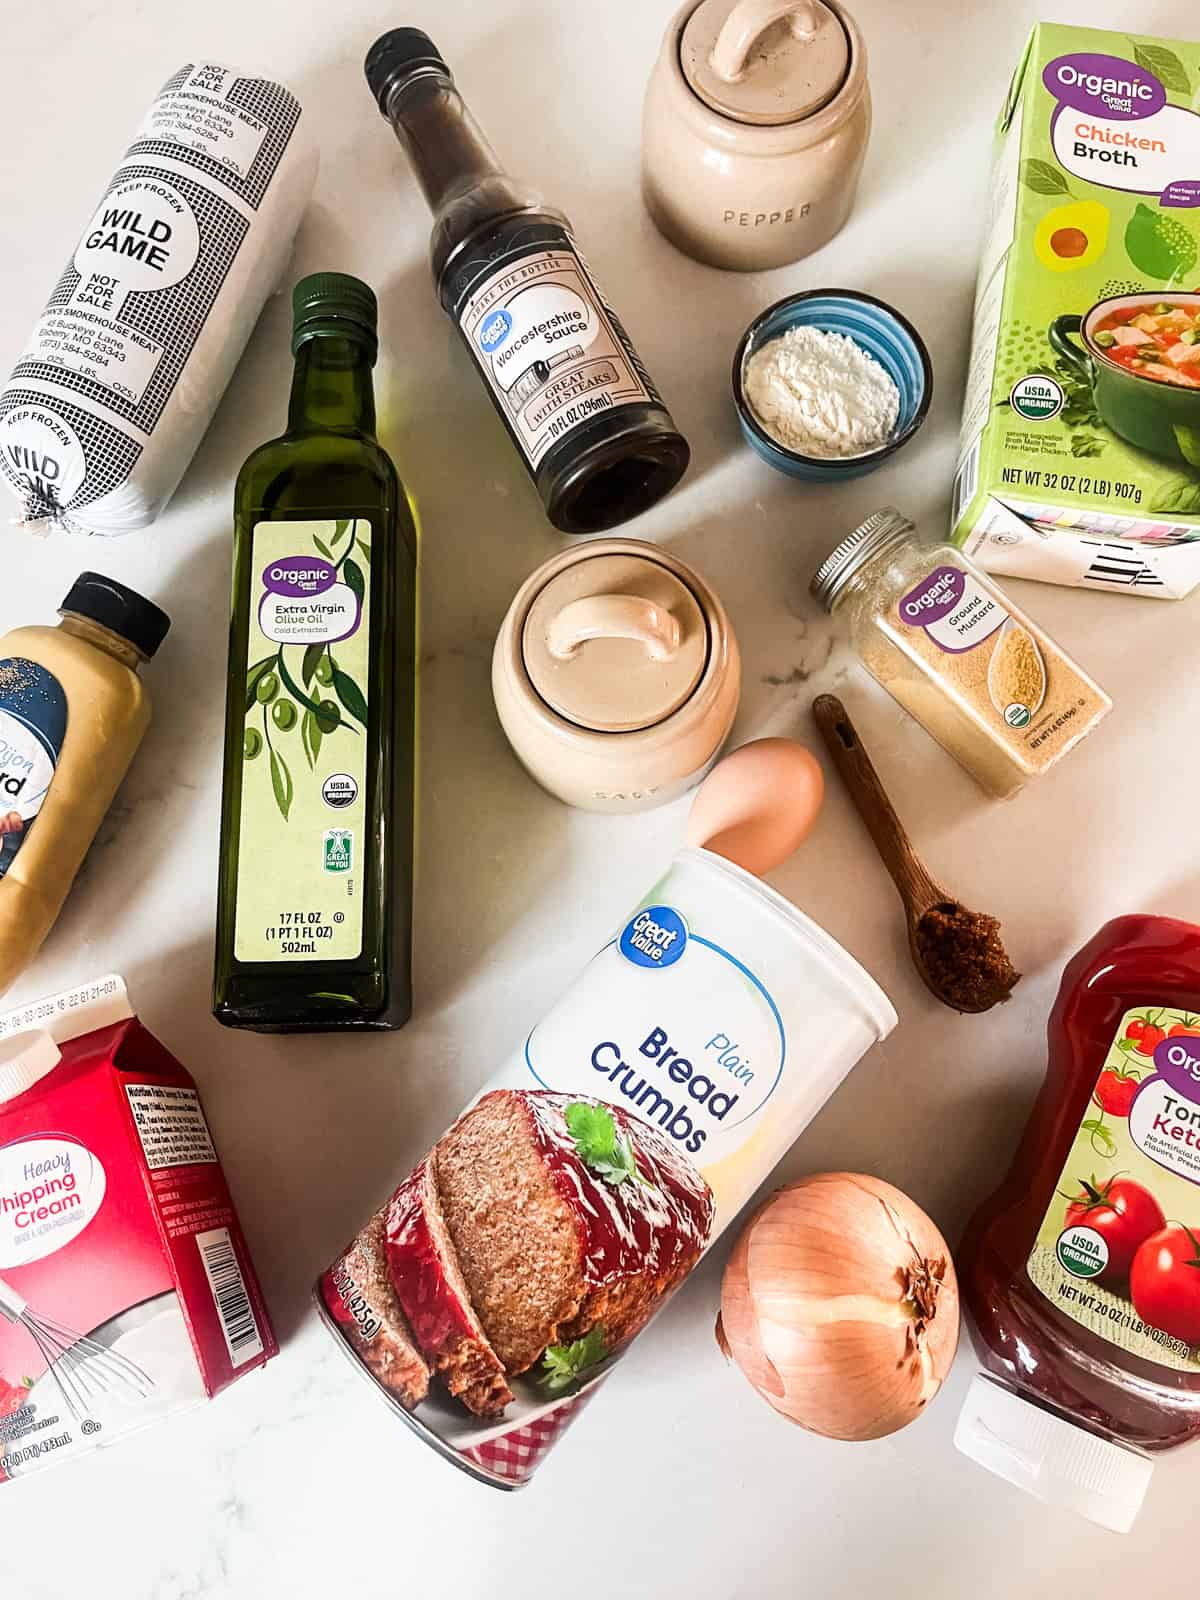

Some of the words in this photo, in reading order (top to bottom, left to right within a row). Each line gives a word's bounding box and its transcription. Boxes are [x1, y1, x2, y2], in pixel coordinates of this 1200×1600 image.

[197, 71, 224, 83] FOR
[202, 64, 230, 75] NOT
[1057, 65, 1153, 100] Organic
[190, 78, 223, 93] SALE
[1101, 94, 1132, 108] Great
[208, 109, 232, 127] Lane
[238, 111, 263, 131] MEAT
[1074, 123, 1167, 153] Chicken
[1072, 141, 1139, 168] Broth
[143, 183, 184, 213] FROZEN
[101, 209, 172, 243] WILD
[723, 202, 810, 227] PEPPER
[84, 230, 170, 272] GAME
[89, 273, 120, 289] NOT
[498, 273, 519, 292] THE
[520, 260, 562, 278] BOTTLE
[76, 292, 113, 312] SALE
[84, 283, 114, 299] FOR
[63, 308, 130, 338] SMOKEHOUSE
[130, 333, 159, 355] MEAT
[97, 331, 125, 351] Lane
[496, 310, 583, 368] Worcestershire
[543, 321, 588, 345] Sauce
[61, 342, 110, 368] 384-5284
[72, 332, 92, 345] MO
[93, 339, 127, 363] 63343
[533, 397, 562, 423] WITH
[562, 373, 612, 410] STEAKS
[544, 370, 585, 400] GREAT
[1023, 385, 1052, 398] USDA
[548, 423, 559, 438] 10
[559, 415, 569, 432] FL
[568, 408, 580, 423] OZ
[579, 391, 614, 419] (296mL)
[1019, 398, 1055, 409] ORGANIC
[7, 411, 30, 428] KEEP
[31, 411, 72, 447] FROZEN
[1002, 467, 1022, 485] NET
[1025, 471, 1042, 487] WT
[1043, 473, 1058, 489] 32
[1061, 475, 1075, 492] OZ
[1078, 477, 1090, 494] (2
[1093, 480, 1111, 498] LB)
[1114, 481, 1142, 503] 907g
[270, 567, 329, 585] Organic
[904, 573, 956, 617] Organic
[274, 615, 305, 625] Olive
[306, 614, 323, 624] Oil
[275, 604, 308, 615] Extra
[309, 603, 345, 615] Virgin
[948, 595, 983, 627] Ground
[957, 600, 996, 636] Mustard
[291, 625, 328, 634] Extracted
[330, 781, 351, 790] USDA
[326, 852, 349, 861] GREAT
[335, 860, 349, 869] YOU
[279, 912, 292, 924] 17
[294, 912, 306, 924] FL
[308, 911, 321, 924] OZ
[633, 911, 677, 949] Great
[265, 927, 275, 941] (1
[278, 927, 291, 939] PT
[294, 927, 300, 938] 1
[302, 926, 314, 938] FL
[316, 926, 333, 939] OZ)
[630, 930, 662, 960] Value
[281, 941, 317, 953] 502mL
[704, 1032, 755, 1088] Plain
[638, 1026, 740, 1121] Bread
[590, 1041, 707, 1153] Crumbs
[1145, 1133, 1158, 1143] No
[1158, 1139, 1193, 1160] Artificial
[23, 1151, 71, 1181] Heavy
[0, 1172, 76, 1213] hipping
[15, 1193, 81, 1228] Cream
[1070, 1233, 1100, 1257] USDA
[1062, 1246, 1100, 1271] ORGANIC
[338, 1275, 355, 1298] OZ
[343, 1289, 384, 1340] (425g)
[1058, 1283, 1079, 1302] NET
[1095, 1301, 1108, 1316] 20
[1108, 1306, 1123, 1323] OZ
[1130, 1315, 1144, 1334] LB
[1143, 1325, 1151, 1337] 4
[1151, 1326, 1168, 1348] OZ)
[1166, 1336, 1189, 1360] 567g
[40, 1431, 73, 1453] 473mL
